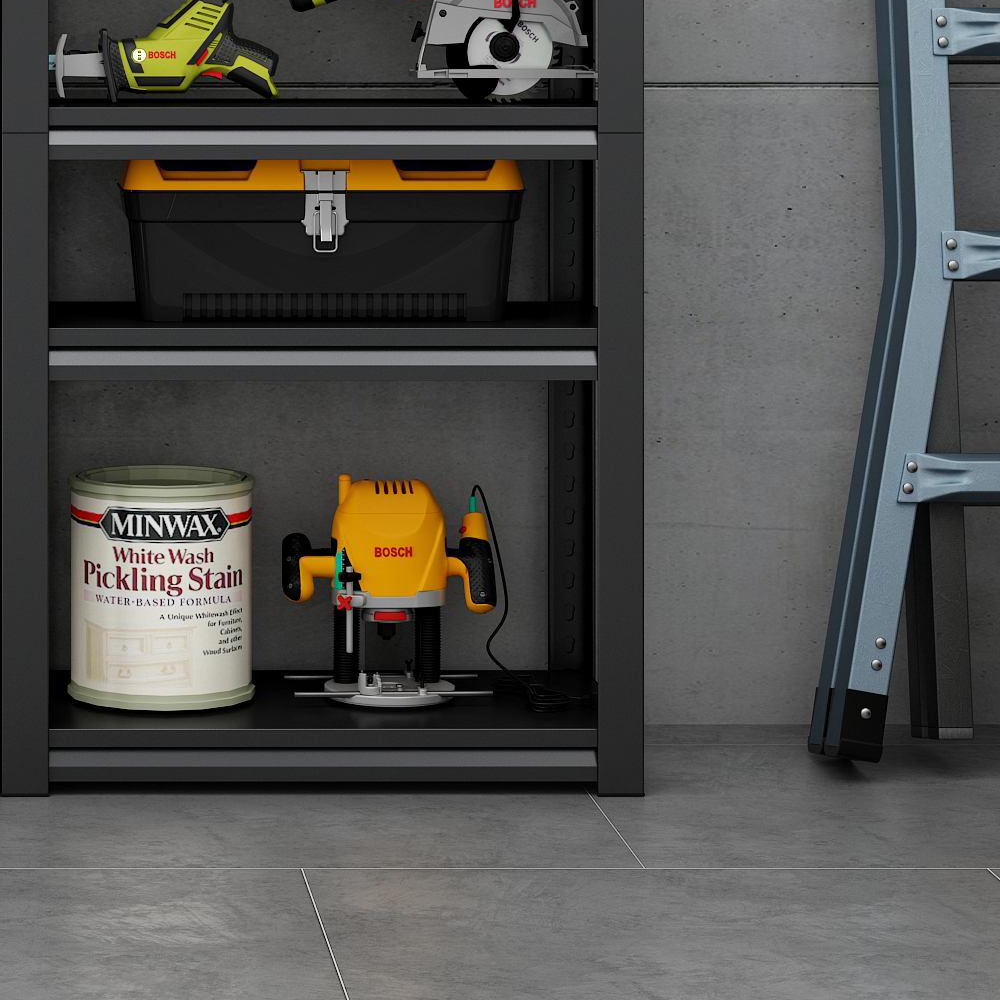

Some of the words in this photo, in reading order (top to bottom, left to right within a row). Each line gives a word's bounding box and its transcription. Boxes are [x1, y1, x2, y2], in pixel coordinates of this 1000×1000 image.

[517, 21, 539, 43] BOSCH
[148, 51, 176, 59] BOSCH
[111, 512, 220, 537] MINWAX
[113, 546, 165, 564] White
[168, 548, 214, 564] Wash
[374, 547, 413, 557] BOSCH
[84, 559, 183, 597] Pickling
[189, 565, 243, 591] Stain
[95, 594, 175, 607] WATER-BASED
[180, 595, 231, 606] FORMULA
[167, 613, 194, 621] Unique
[195, 610, 228, 619] Whitewash
[218, 637, 229, 645] and
[203, 648, 221, 656] Wood
